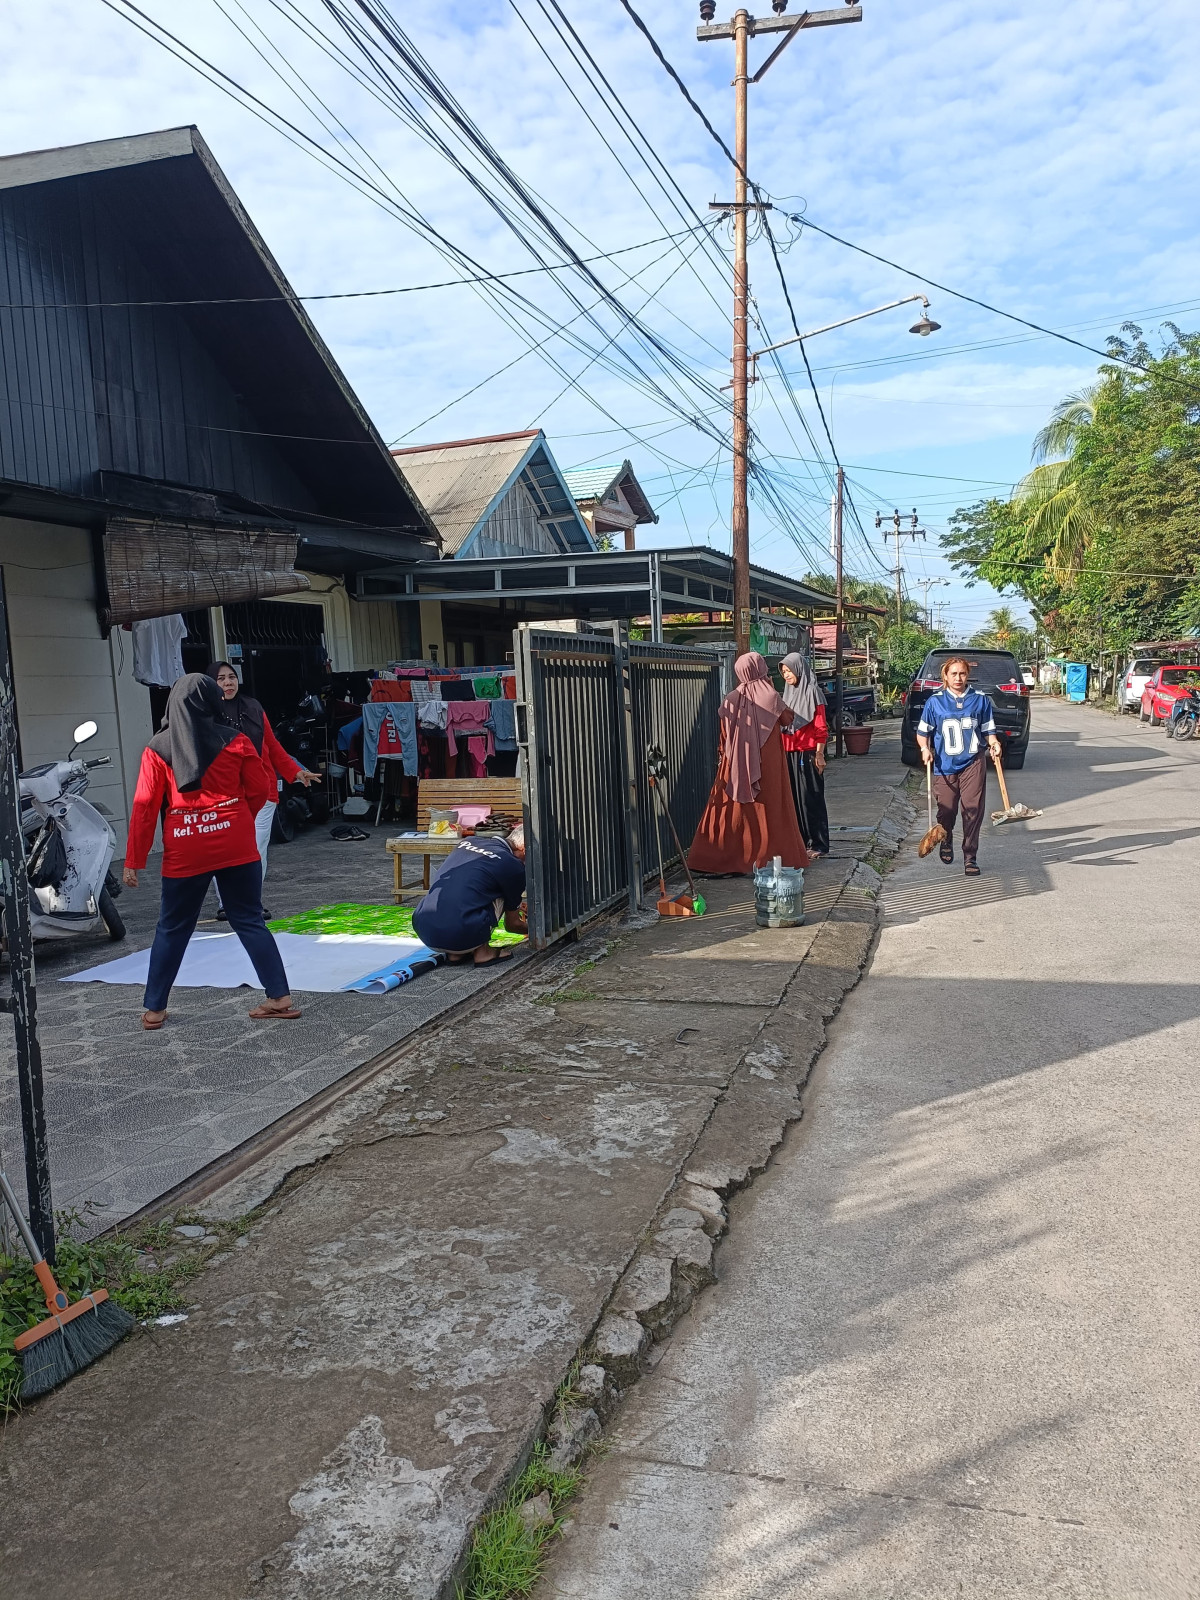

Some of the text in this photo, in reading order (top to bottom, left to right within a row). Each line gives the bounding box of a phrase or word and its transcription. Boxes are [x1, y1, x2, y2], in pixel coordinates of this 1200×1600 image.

[183, 811, 218, 825] RT 09
[173, 820, 231, 838] Kel. Tenun
[457, 840, 502, 860] Paser
